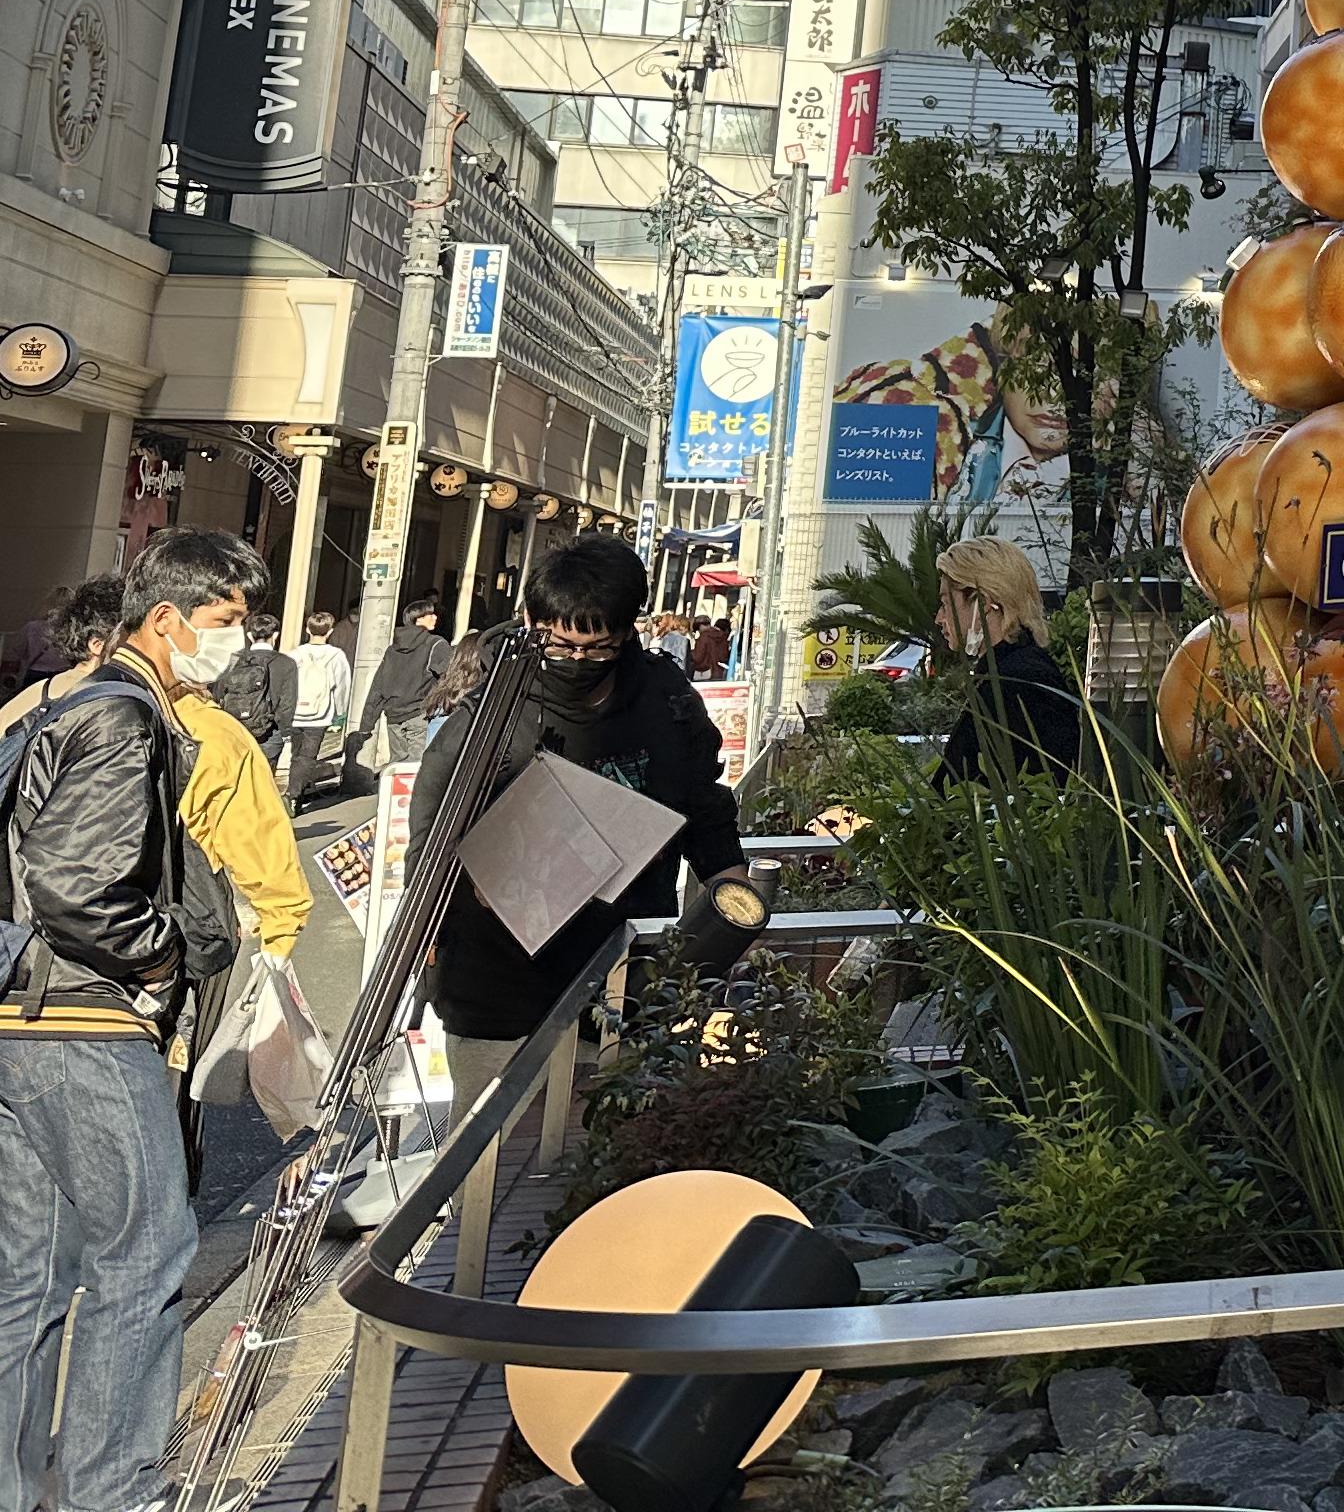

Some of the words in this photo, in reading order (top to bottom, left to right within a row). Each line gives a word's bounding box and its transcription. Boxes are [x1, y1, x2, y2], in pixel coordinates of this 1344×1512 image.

[691, 283, 748, 298] LENS
[688, 409, 771, 437] 試せる
[839, 425, 924, 440] ブルーライトカット
[837, 448, 927, 461] コンタクトといえば、
[835, 469, 894, 482] レンズリスト。
